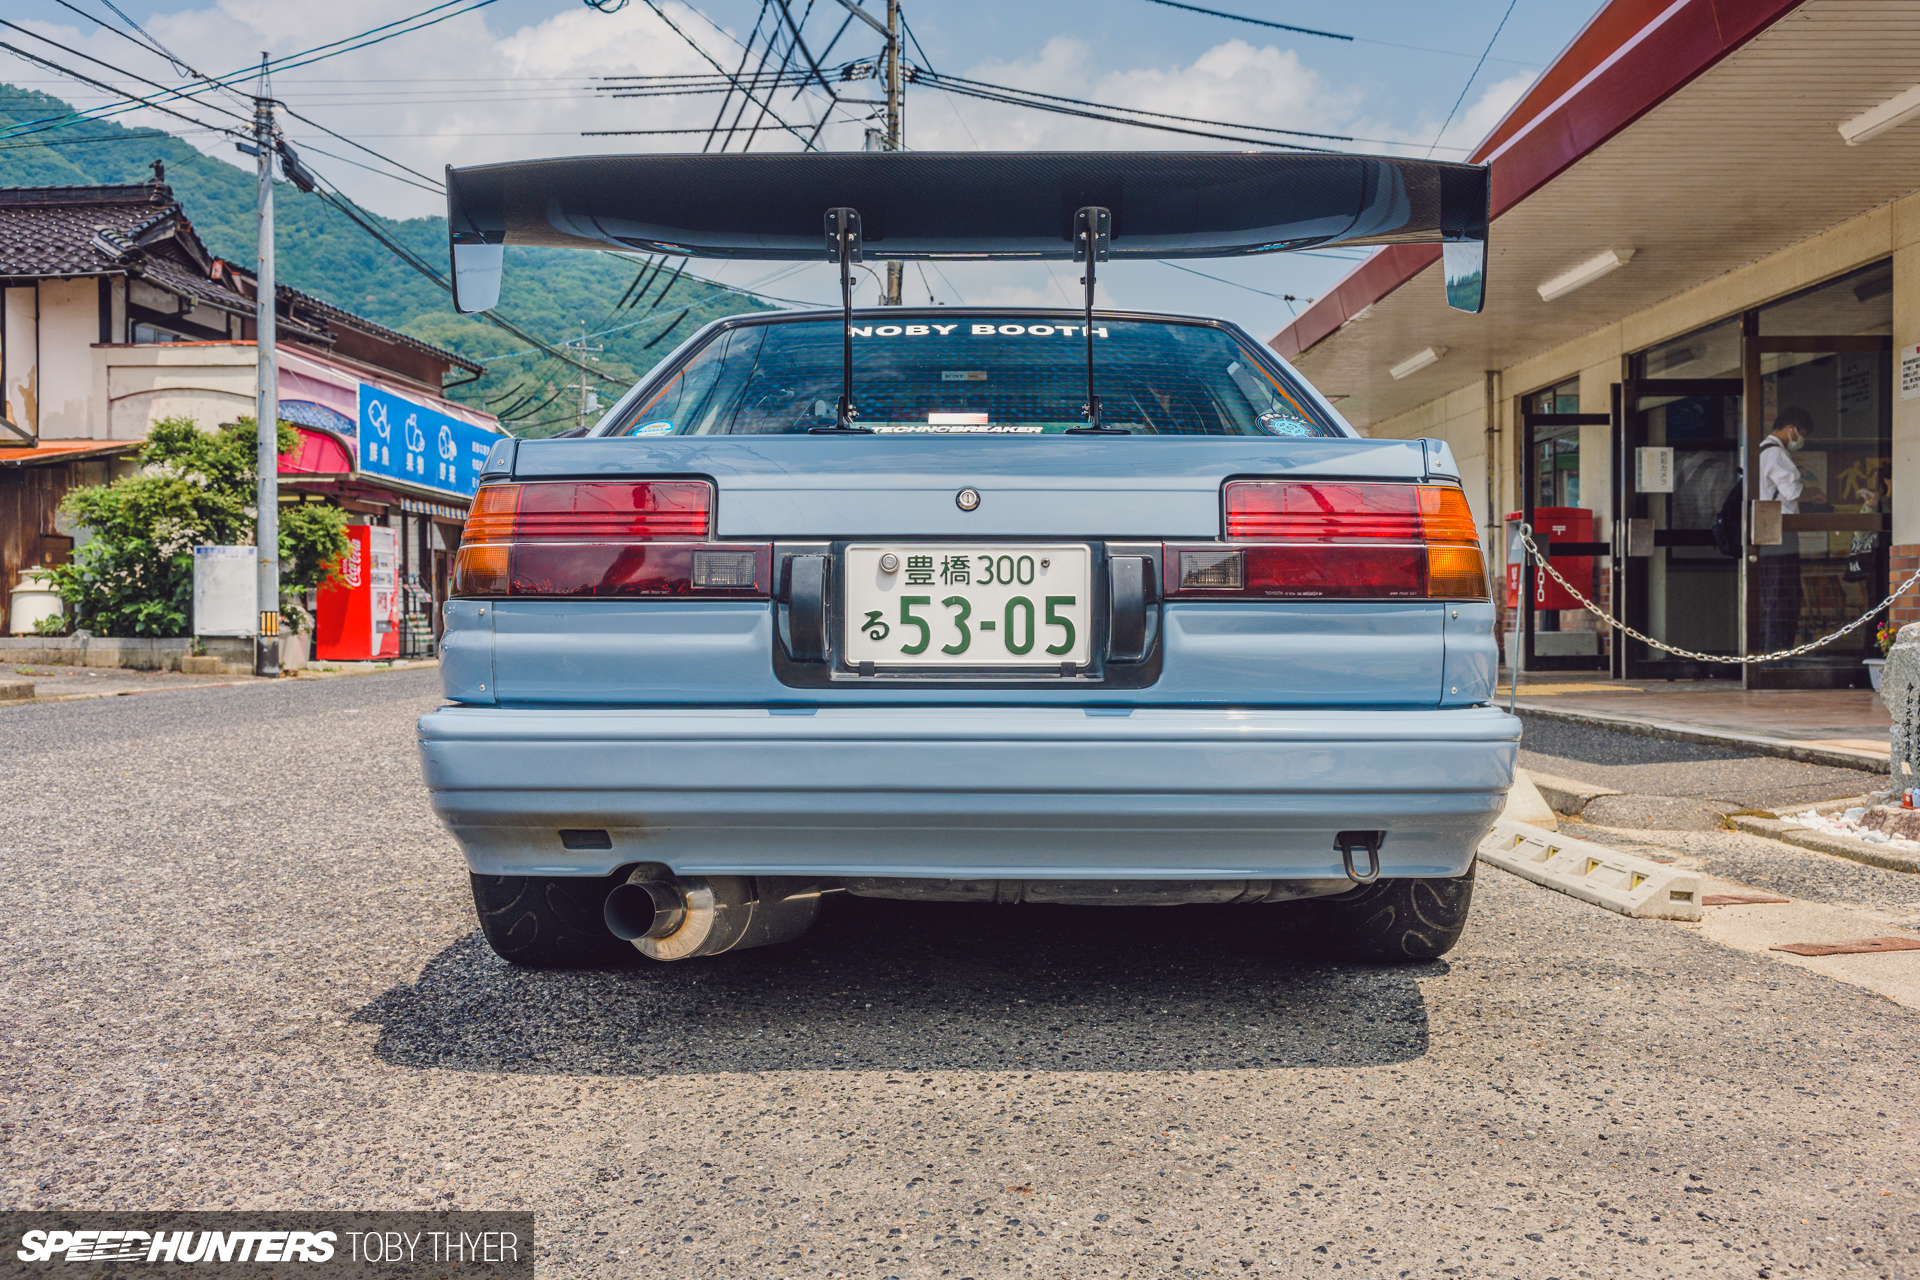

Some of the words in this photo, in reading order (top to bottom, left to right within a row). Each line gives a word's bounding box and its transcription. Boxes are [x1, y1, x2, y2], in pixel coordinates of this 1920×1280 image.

[849, 324, 958, 337] NOBY
[971, 324, 1109, 338] BOOTH
[871, 426, 1044, 434] TECHNOBREAKER
[904, 554, 971, 586] 豊橋
[976, 554, 1036, 586] 300
[861, 610, 890, 641] る
[900, 595, 1077, 656] 53-05
